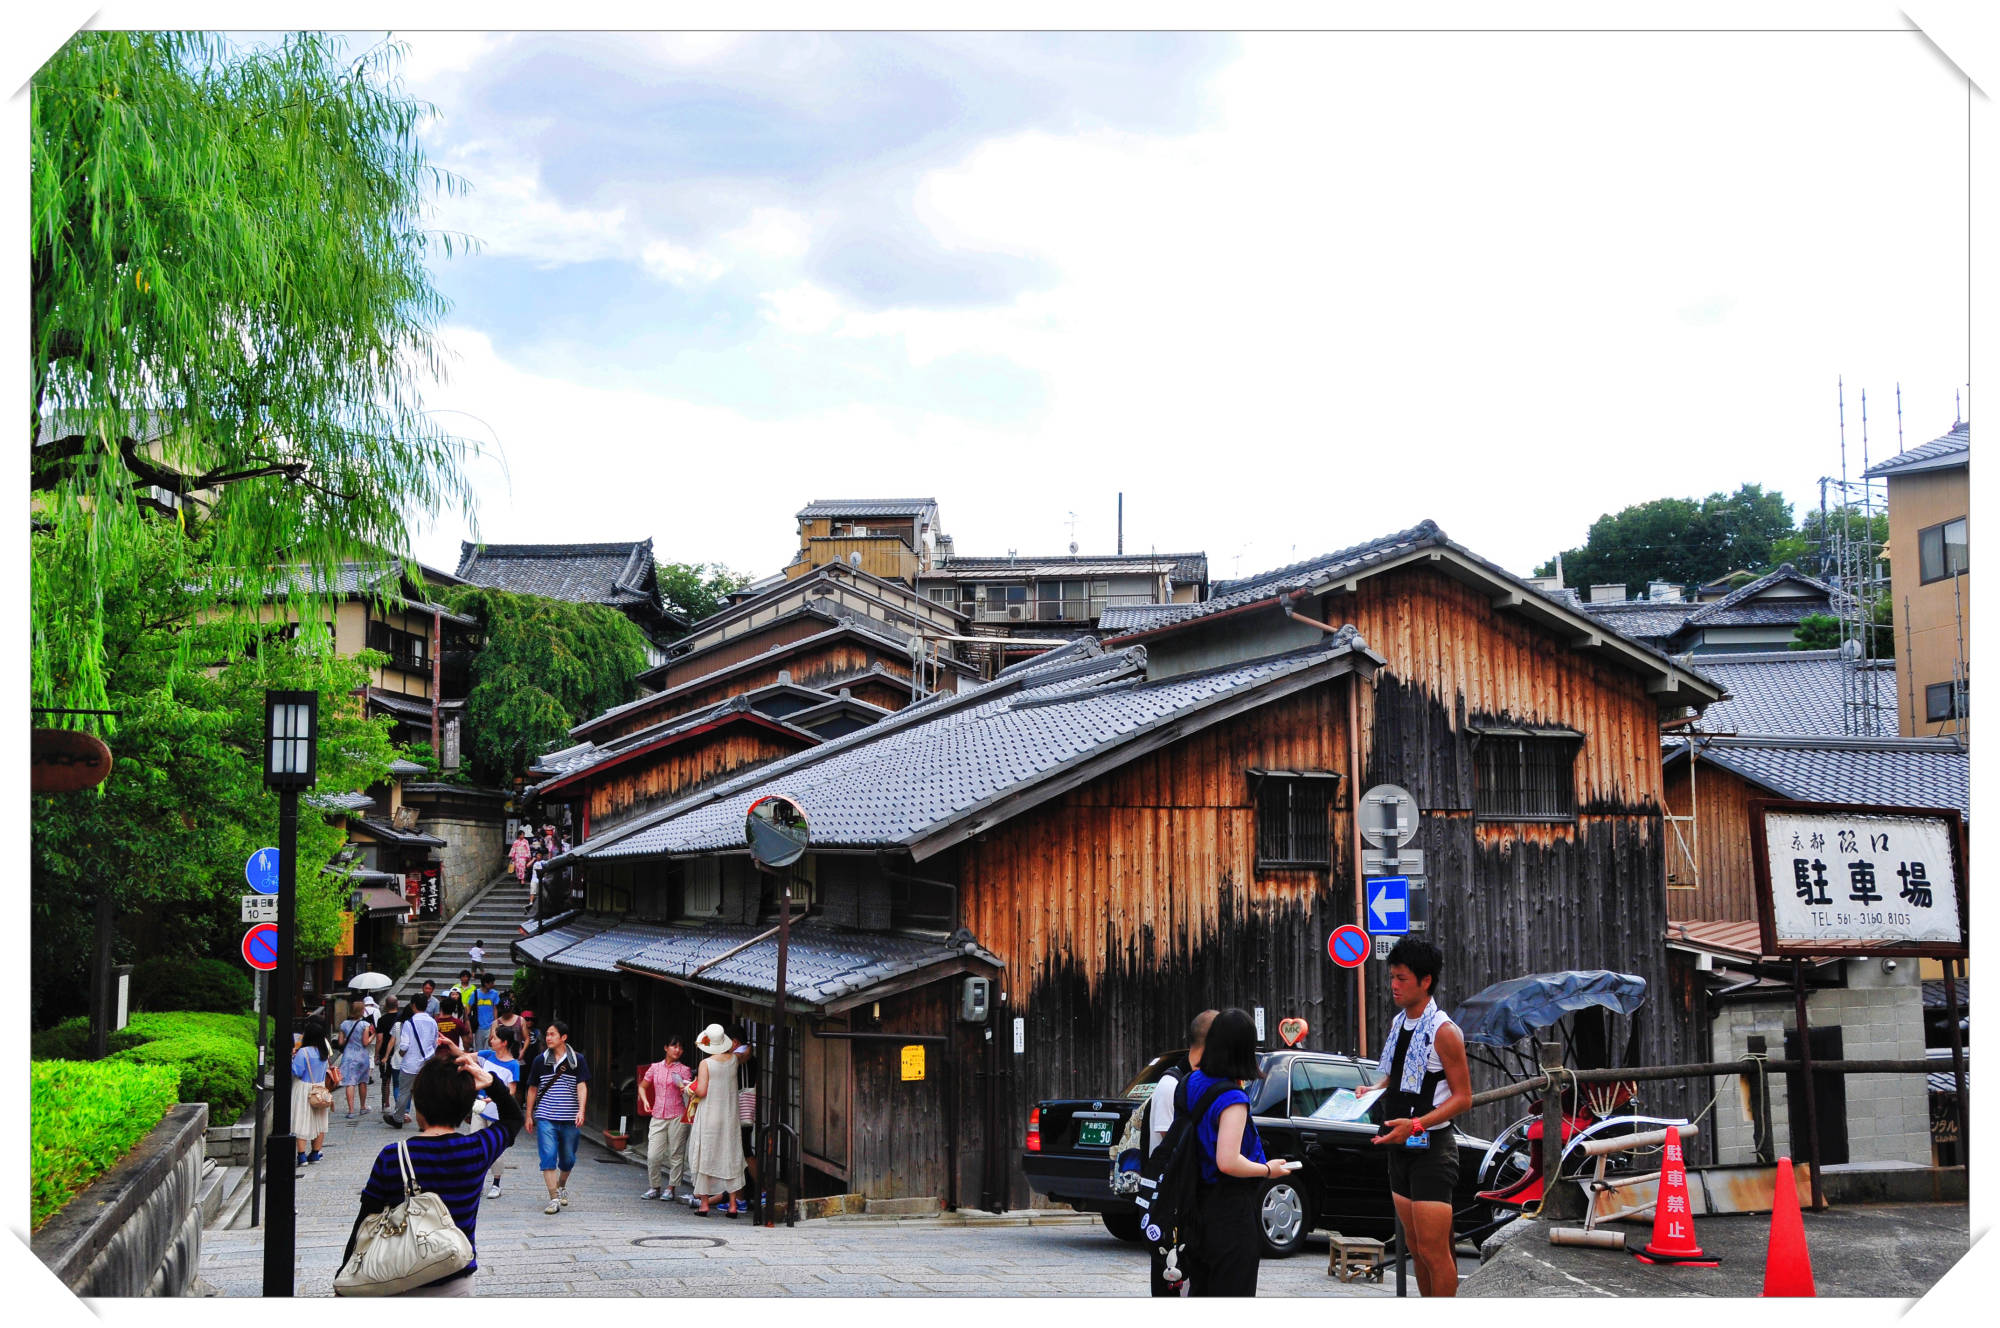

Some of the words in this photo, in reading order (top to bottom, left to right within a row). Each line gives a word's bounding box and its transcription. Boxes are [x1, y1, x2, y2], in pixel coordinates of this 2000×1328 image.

[1793, 858, 1933, 908] 駐車場
[1811, 912, 1832, 926] TEL
[1666, 1144, 1686, 1239] 駐車禁止
